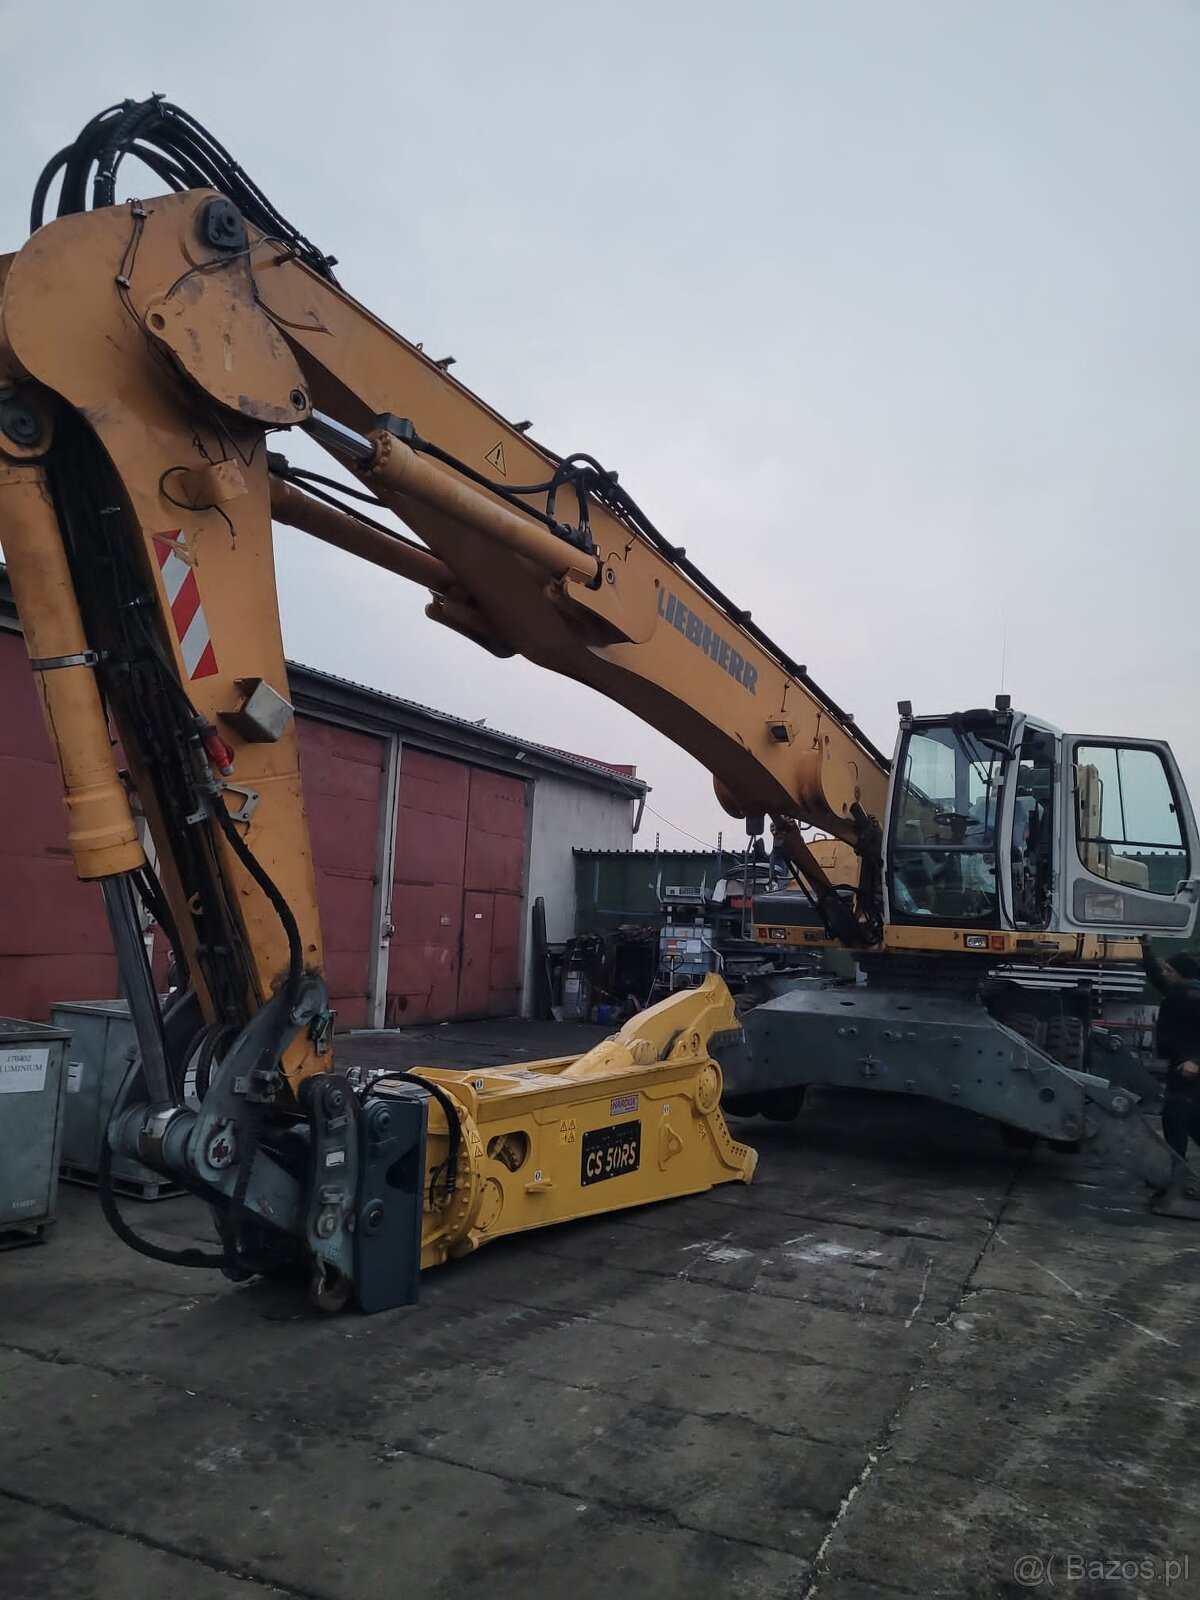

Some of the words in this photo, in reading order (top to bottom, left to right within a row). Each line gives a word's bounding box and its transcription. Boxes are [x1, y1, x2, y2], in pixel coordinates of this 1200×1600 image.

[656, 584, 758, 695] LIEBHERR
[586, 1150, 604, 1178] CS
[605, 1141, 637, 1172] 50RS
